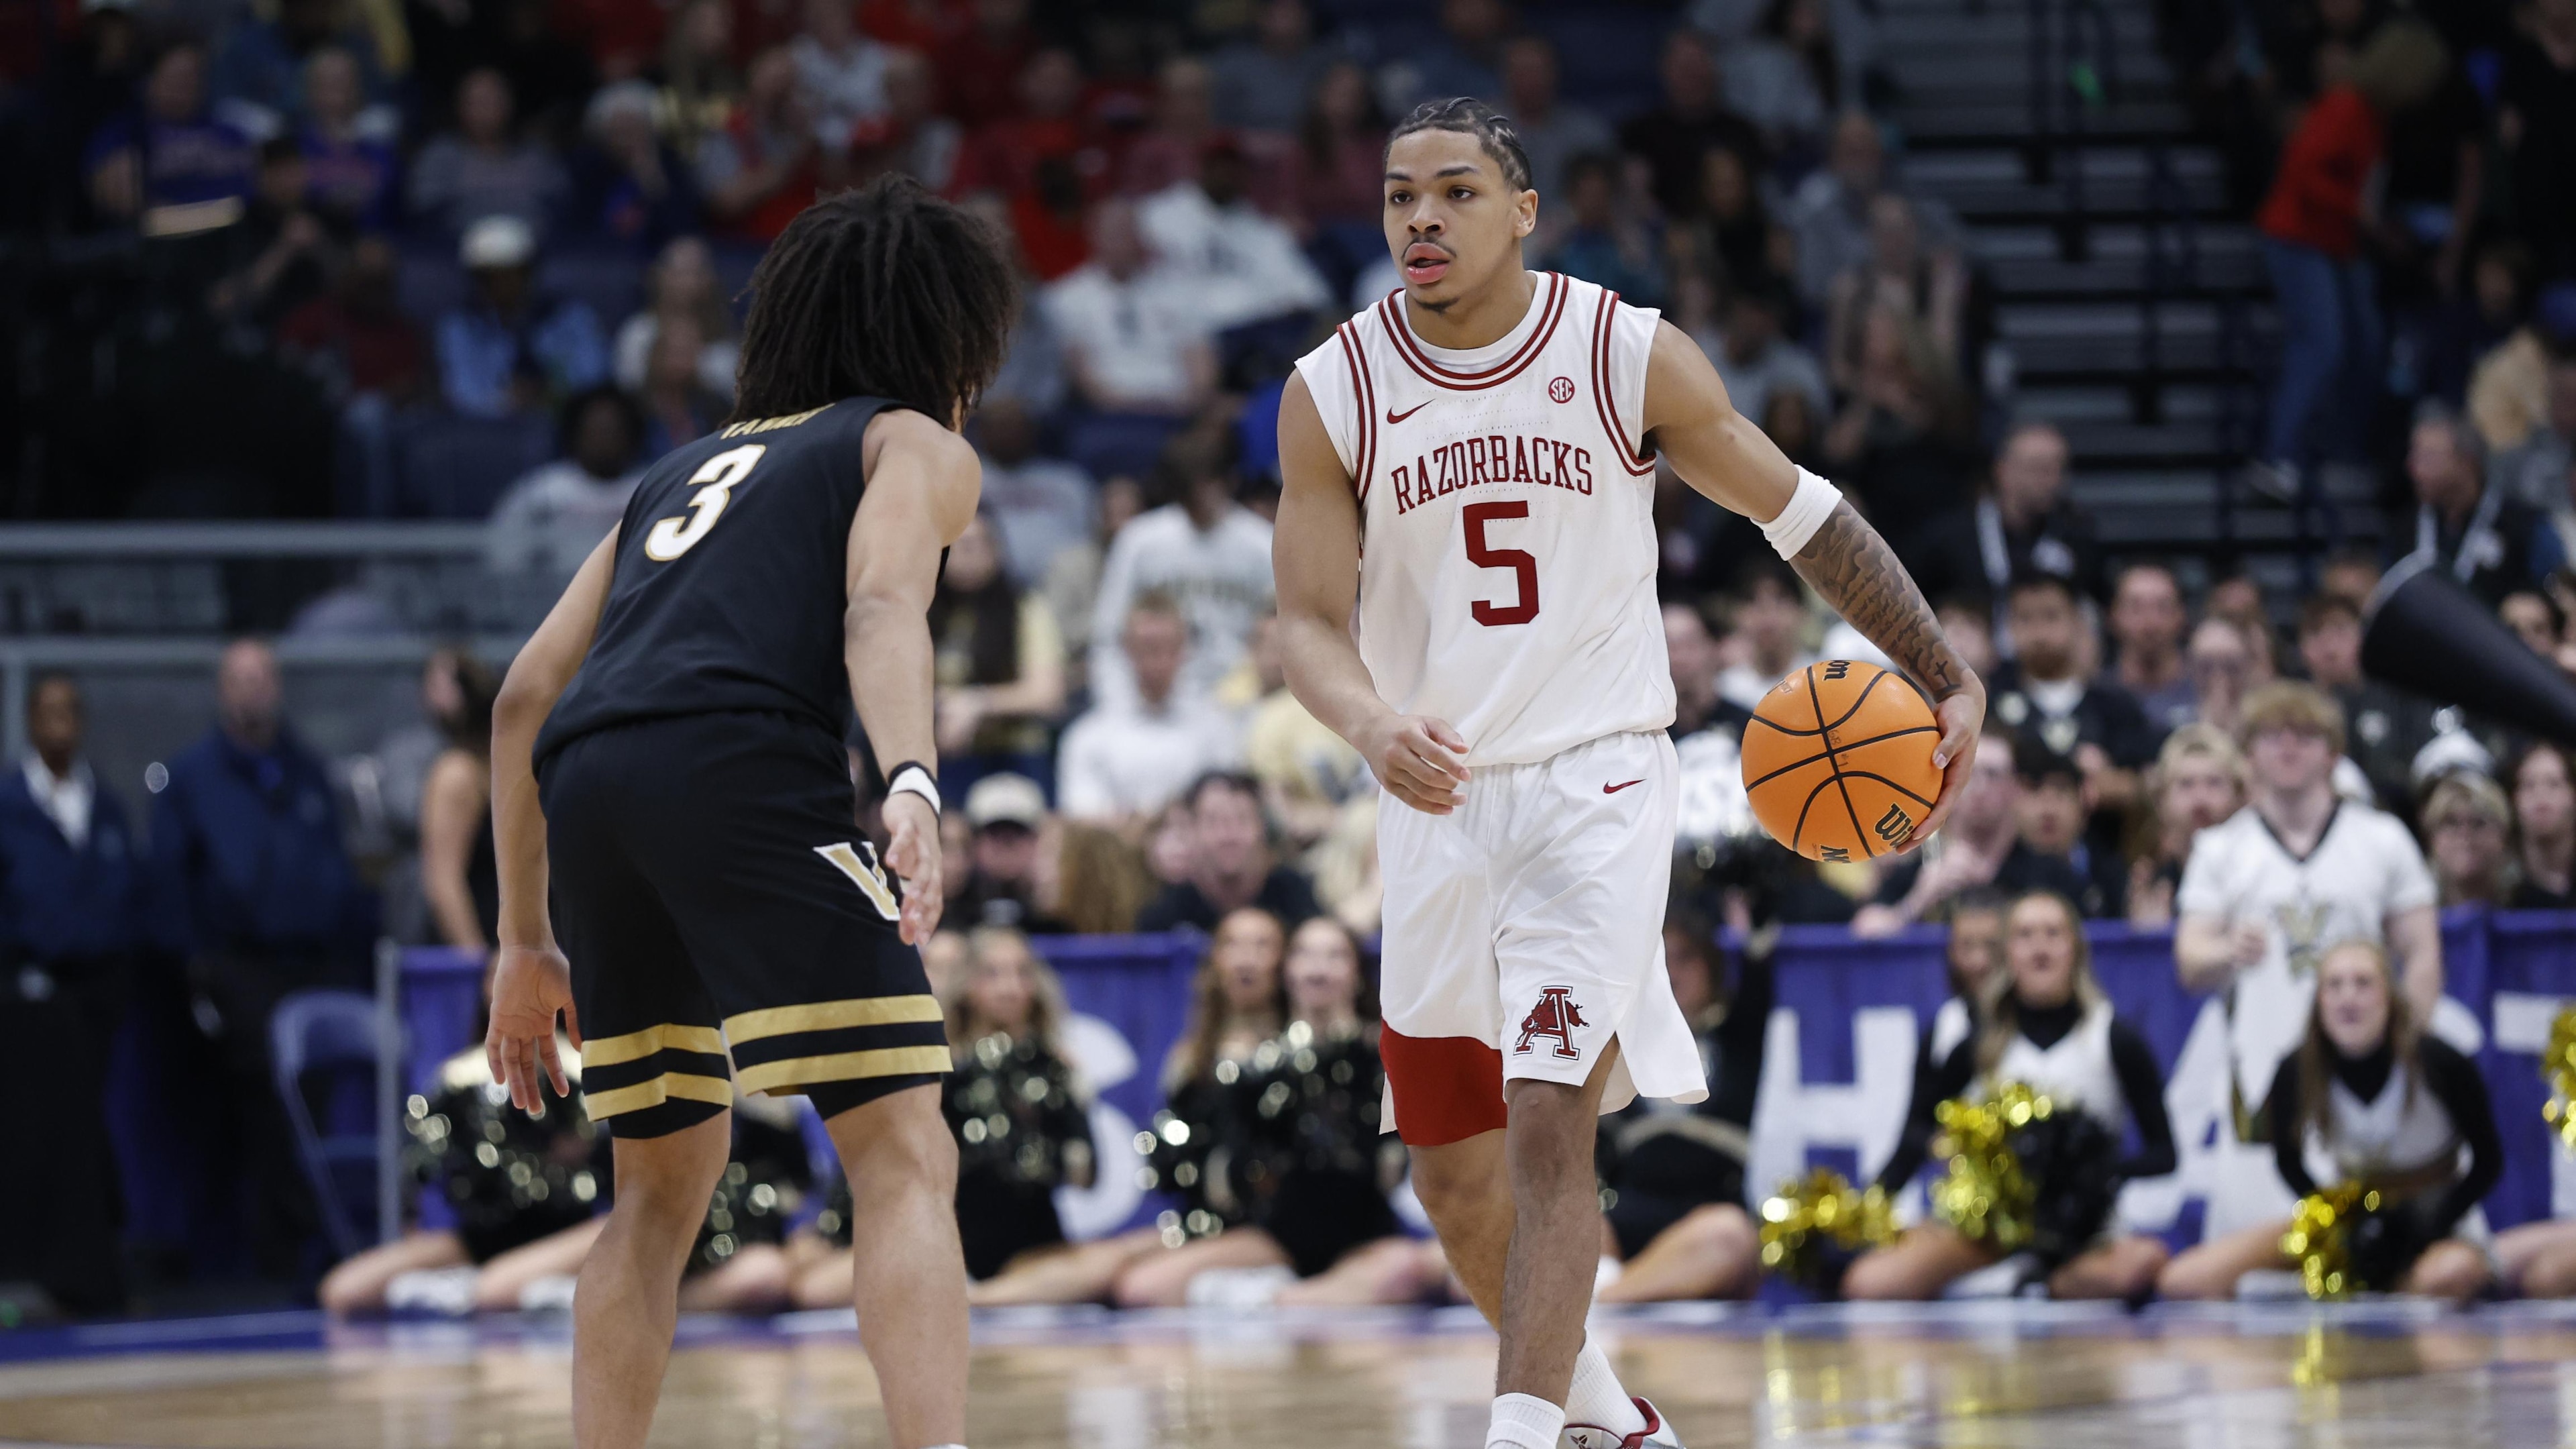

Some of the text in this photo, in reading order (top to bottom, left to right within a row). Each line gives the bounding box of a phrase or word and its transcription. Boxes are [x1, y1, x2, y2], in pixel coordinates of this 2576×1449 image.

[1550, 378, 1573, 401] SEC
[645, 444, 766, 561] 3
[1391, 435, 1592, 515] RAZORBACKS
[1463, 500, 1539, 626] 5
[1513, 985, 1580, 1061] A
